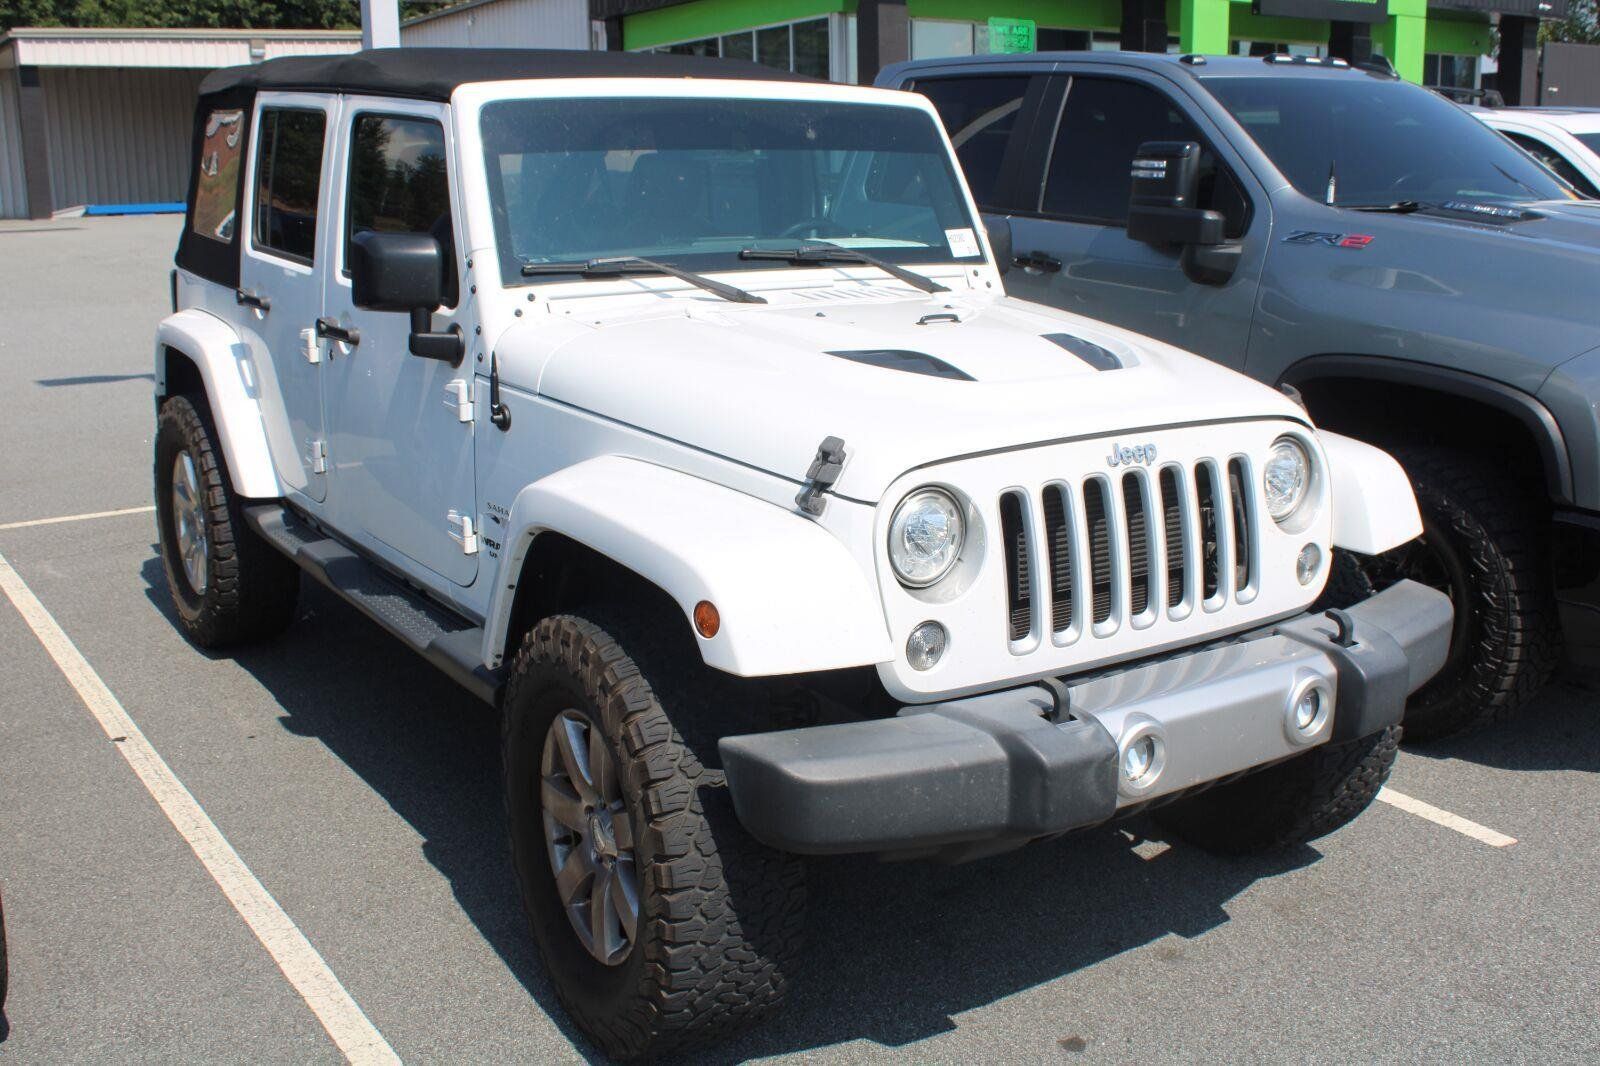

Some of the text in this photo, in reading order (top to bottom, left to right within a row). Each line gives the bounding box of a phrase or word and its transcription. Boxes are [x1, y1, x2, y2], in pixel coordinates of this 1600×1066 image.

[1281, 231, 1374, 249] ZR2
[1106, 443, 1157, 467] Jeep
[487, 502, 510, 517] SAHA
